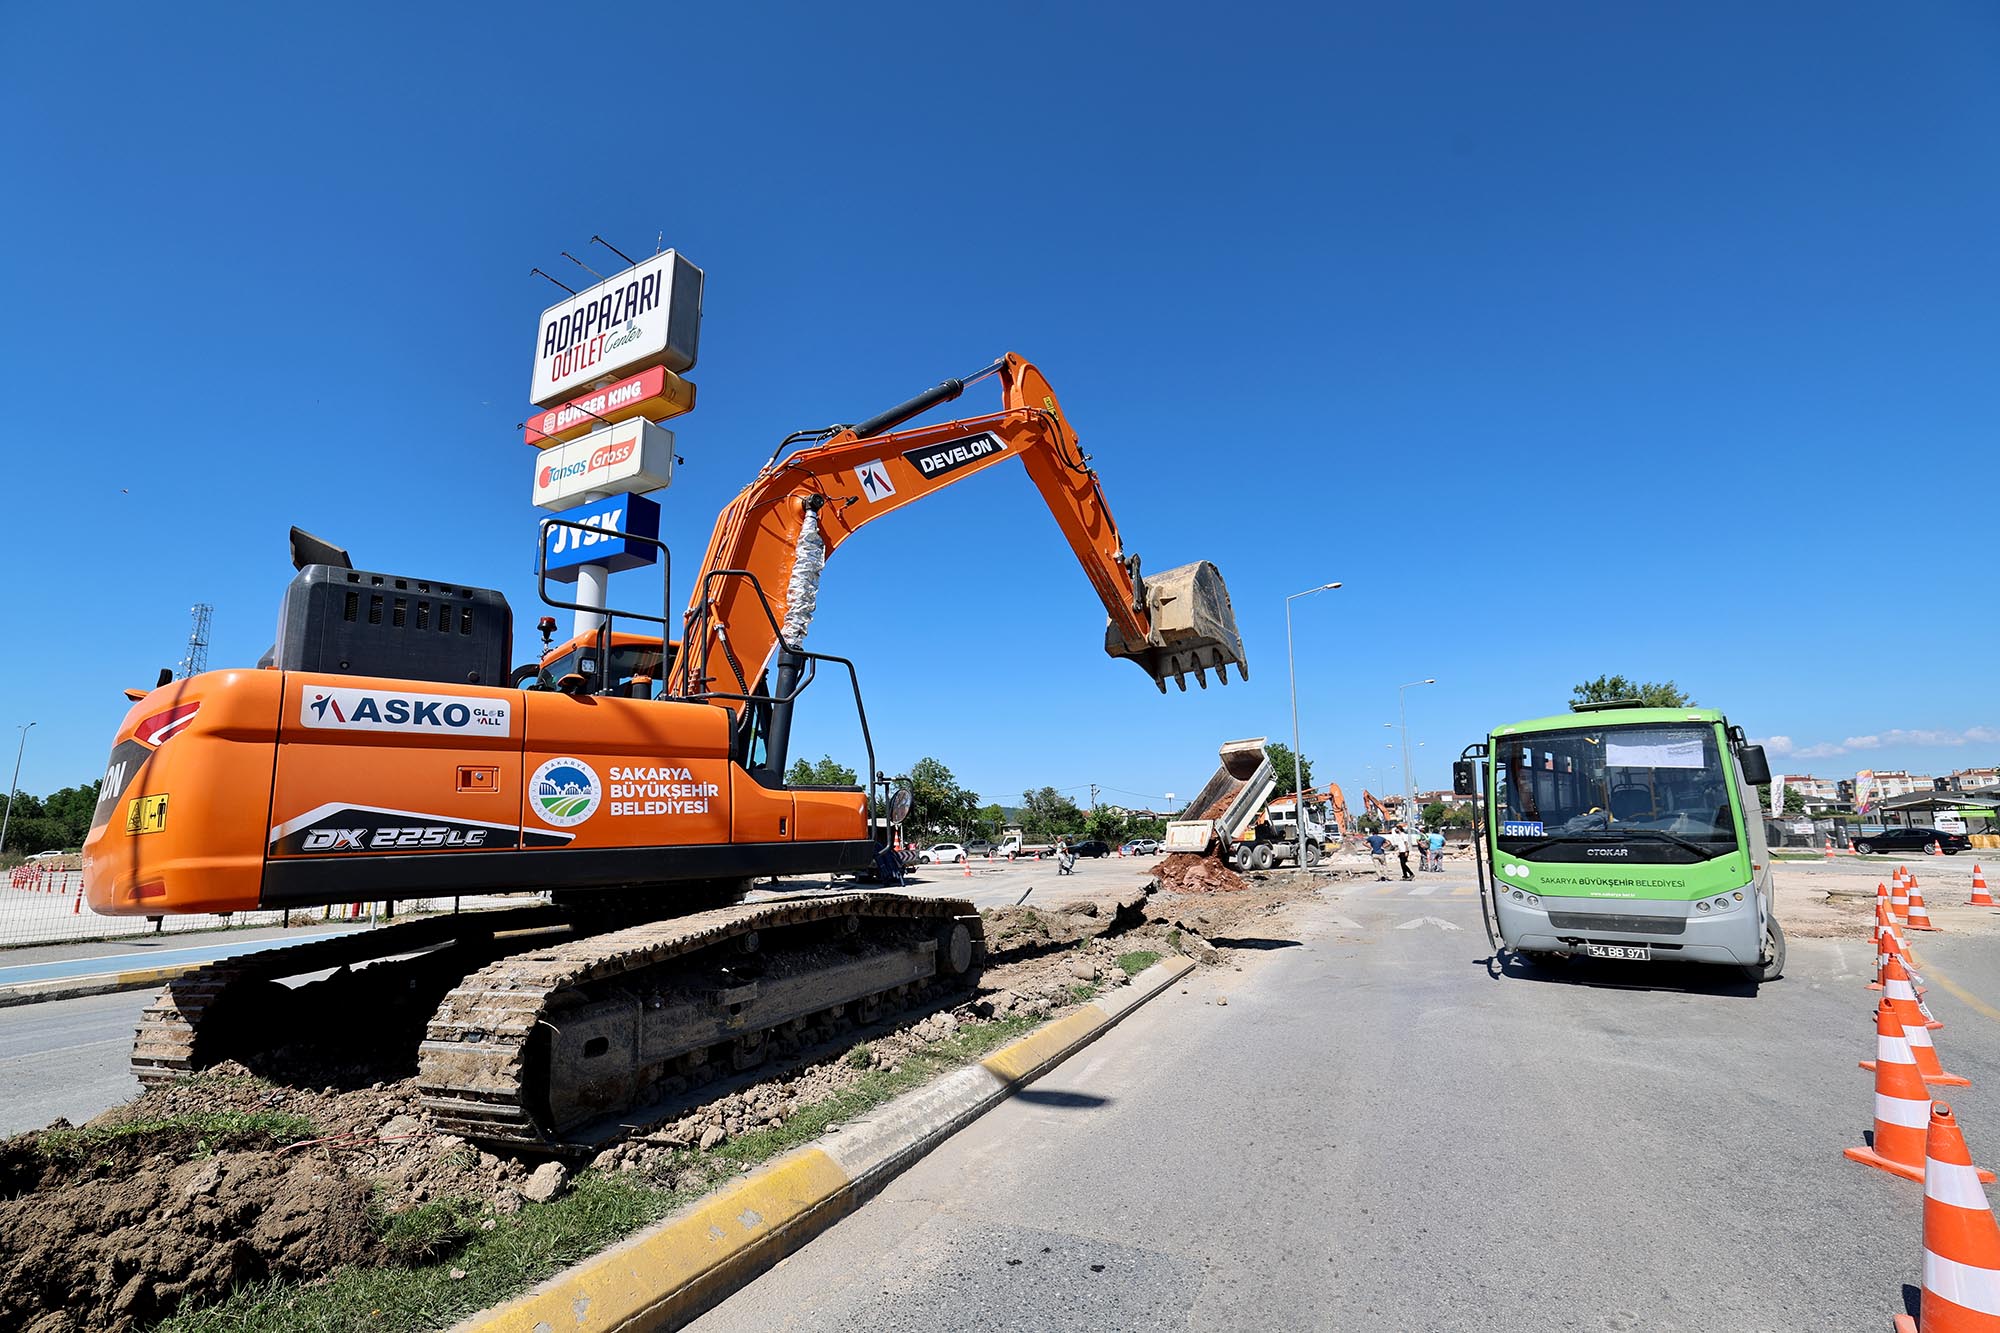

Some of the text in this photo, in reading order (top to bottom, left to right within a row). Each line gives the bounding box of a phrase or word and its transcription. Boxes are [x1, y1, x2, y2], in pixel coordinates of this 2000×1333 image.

[543, 269, 662, 359] ADAPAZARI
[552, 325, 643, 382] OUTLET Center
[557, 394, 606, 427] BURGER
[608, 381, 641, 407] KING
[548, 444, 630, 483] Tansaş Gross
[919, 437, 993, 474] DEVELON
[553, 508, 623, 553] JYSK
[350, 697, 471, 728] ASKO
[545, 760, 587, 771] SAKARYA
[609, 767, 693, 781] SAKARYA
[610, 781, 719, 799] BÜYÜKŞEHİR
[610, 798, 709, 816] BELEDİYESİ
[302, 828, 368, 850] DX
[1505, 823, 1541, 837] SERVİS
[1586, 848, 1629, 856] OTOKAR
[1540, 877, 1686, 888] SAKARYA BÜYÜKŞEHİR BELEDİYESİ
[1592, 946, 1646, 959] 54 BB 971
